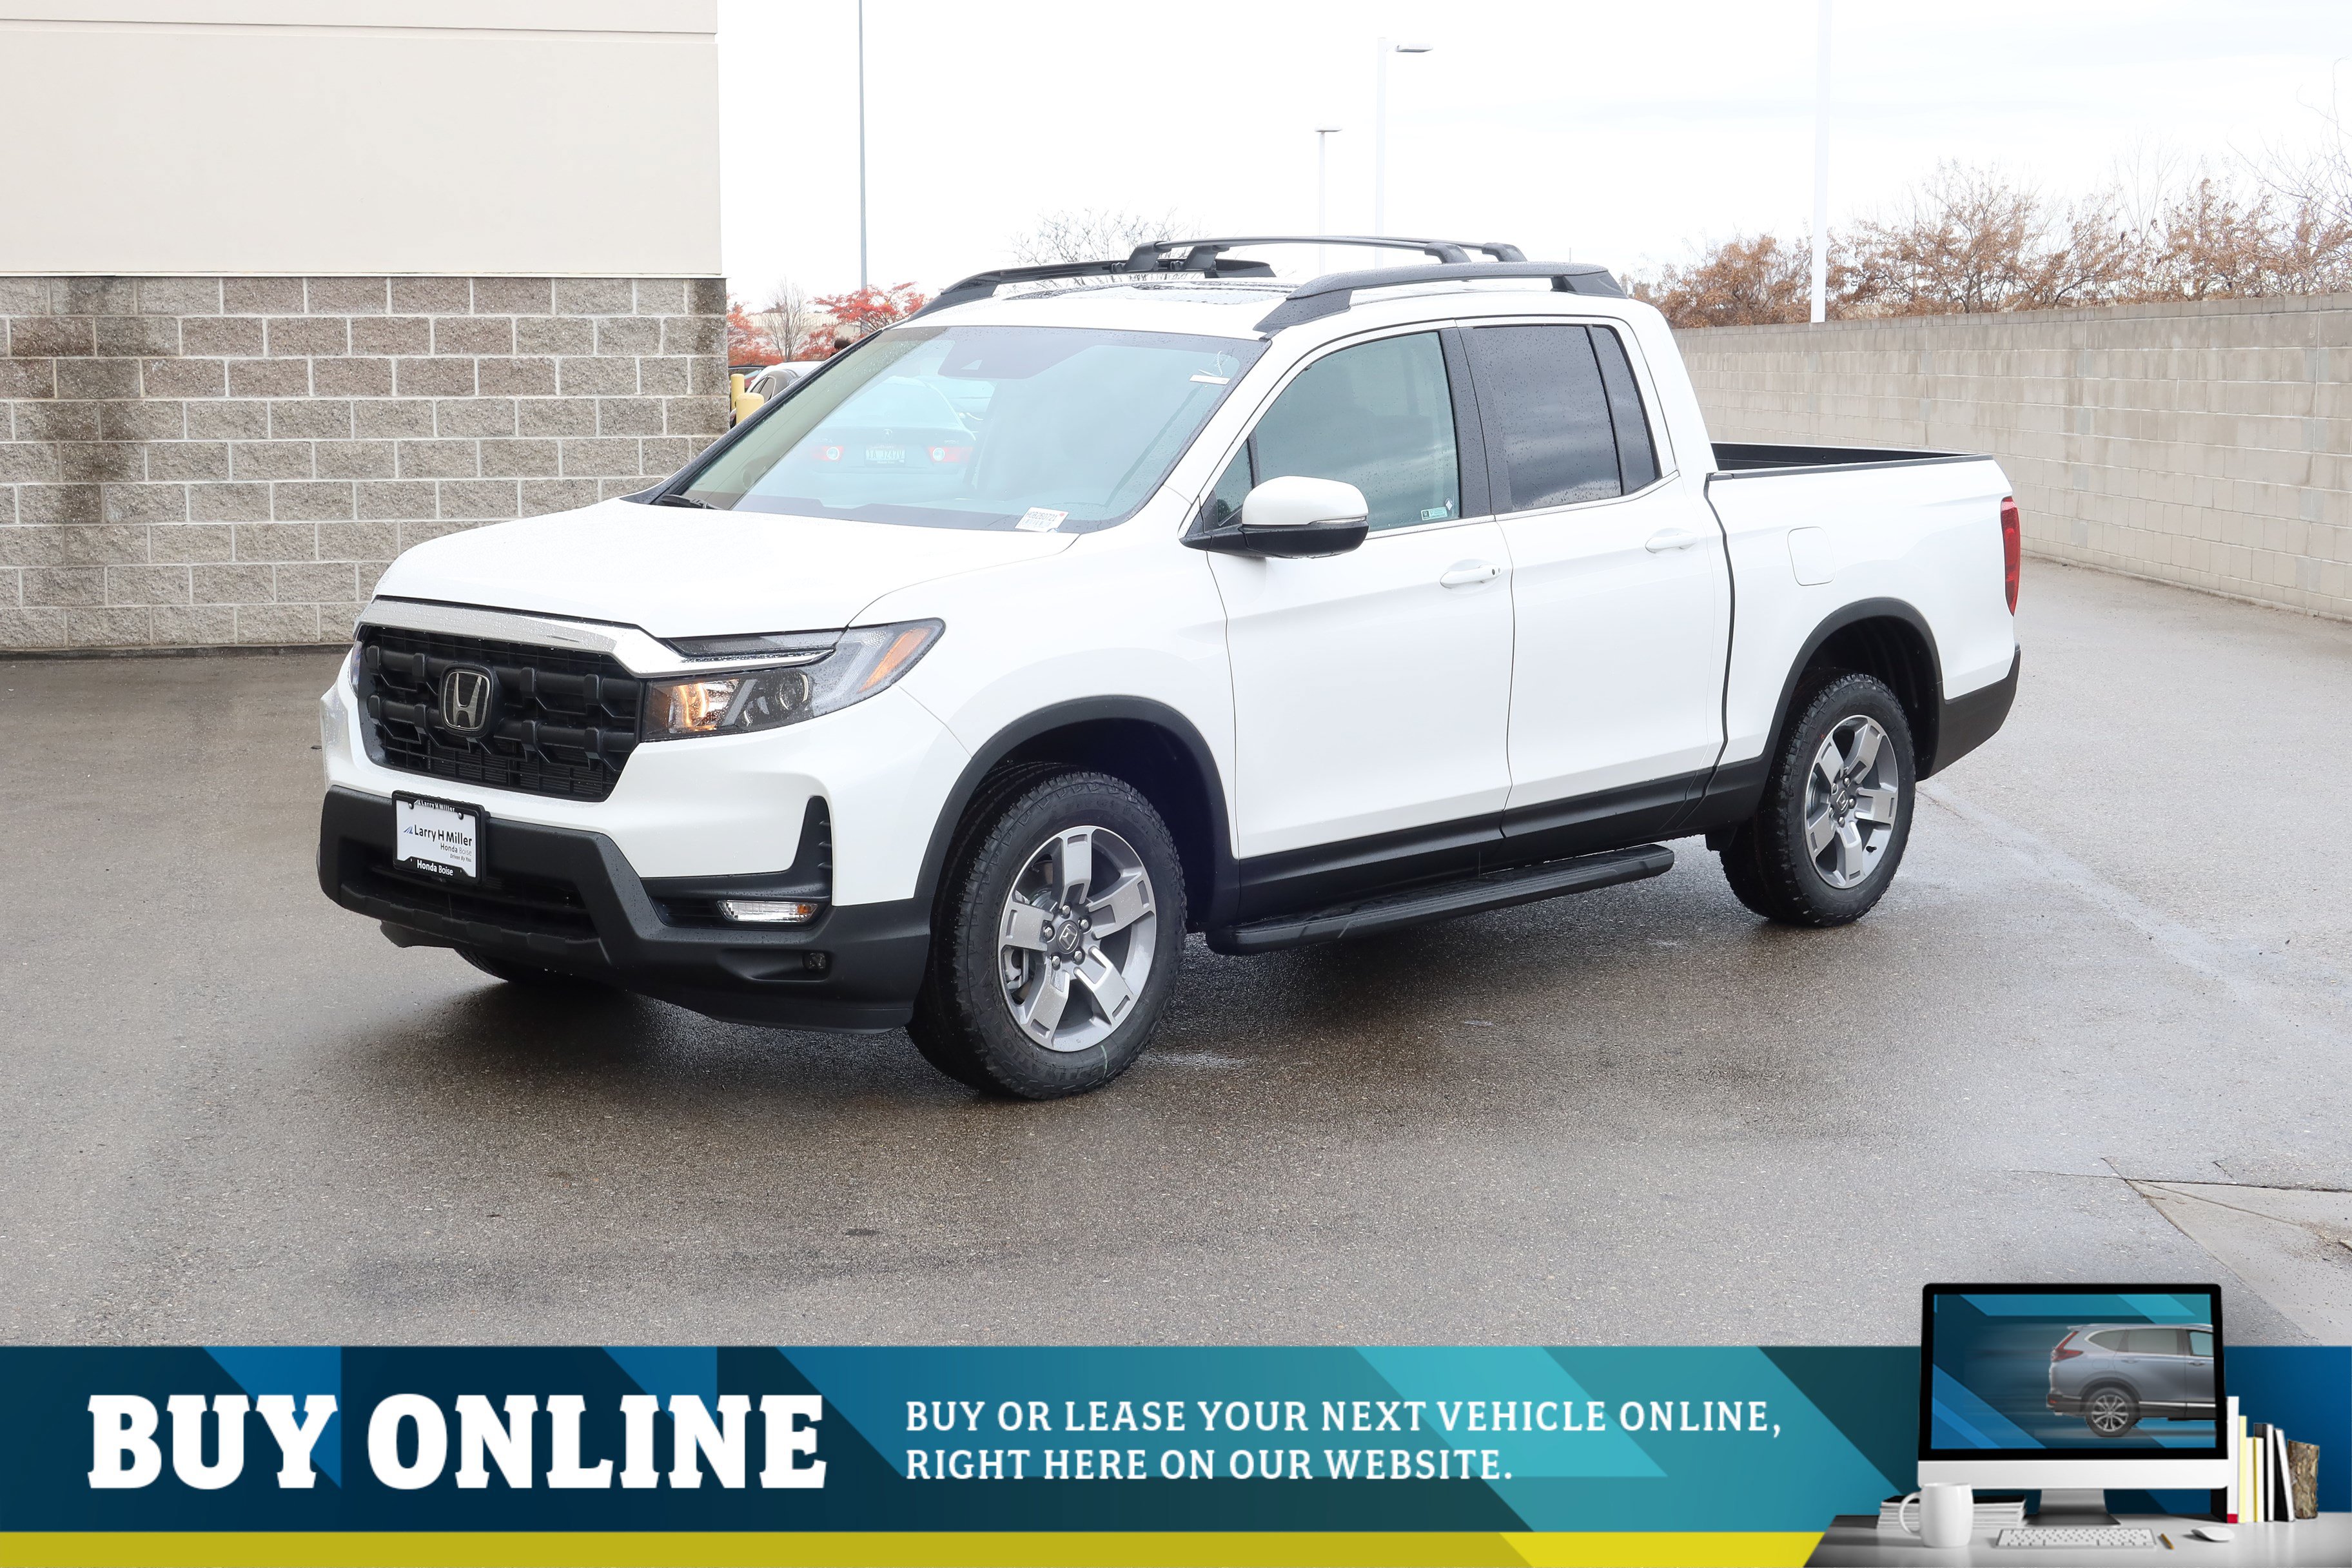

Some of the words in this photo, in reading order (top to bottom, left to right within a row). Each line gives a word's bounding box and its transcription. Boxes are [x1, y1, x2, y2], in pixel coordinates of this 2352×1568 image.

[420, 799, 435, 809] Larry
[440, 803, 455, 812] Miller
[414, 824, 436, 842] Larry
[438, 829, 444, 841] H
[446, 831, 473, 847] Miller
[440, 843, 458, 853] Honda
[458, 847, 472, 856] Boise
[416, 859, 437, 872] Honda
[438, 866, 453, 876] Boise
